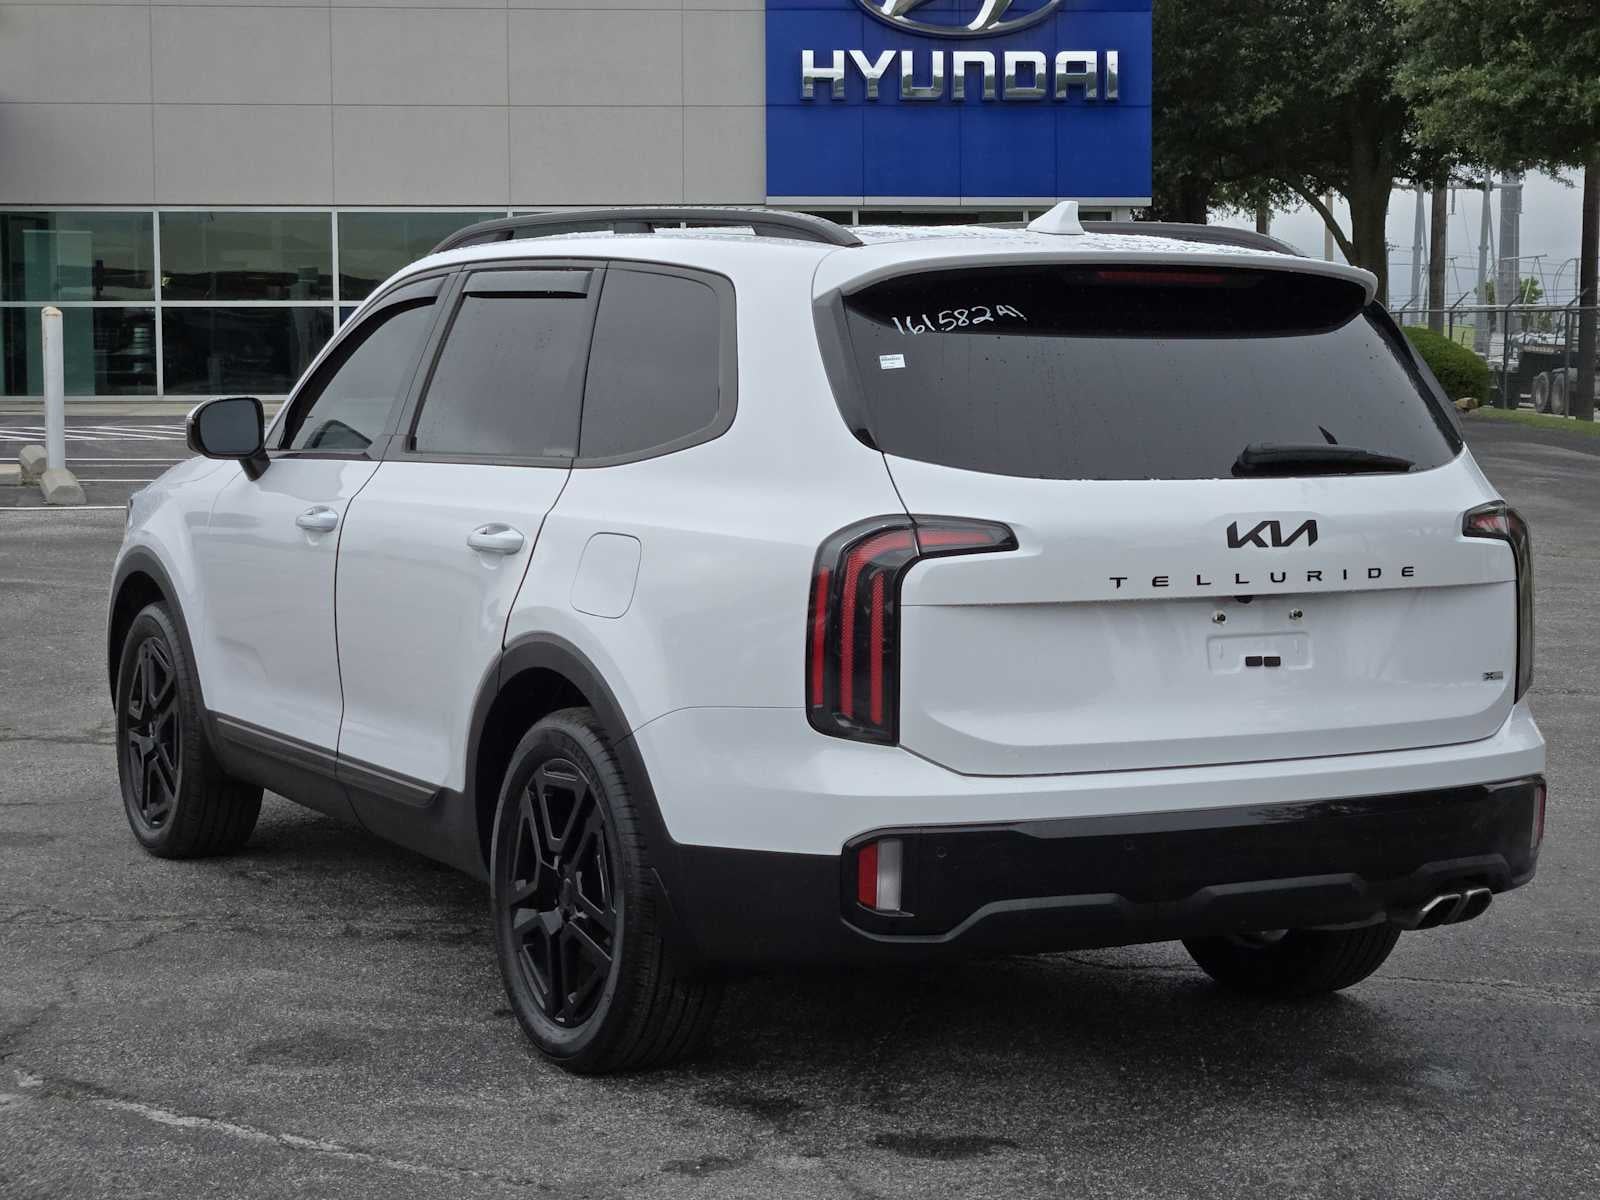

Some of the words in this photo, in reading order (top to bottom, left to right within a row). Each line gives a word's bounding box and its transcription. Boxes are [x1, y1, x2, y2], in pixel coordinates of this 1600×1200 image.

[801, 50, 1119, 99] HYUNDAI
[1227, 519, 1319, 549] KIA
[1109, 566, 1416, 589] TELLURIDE
